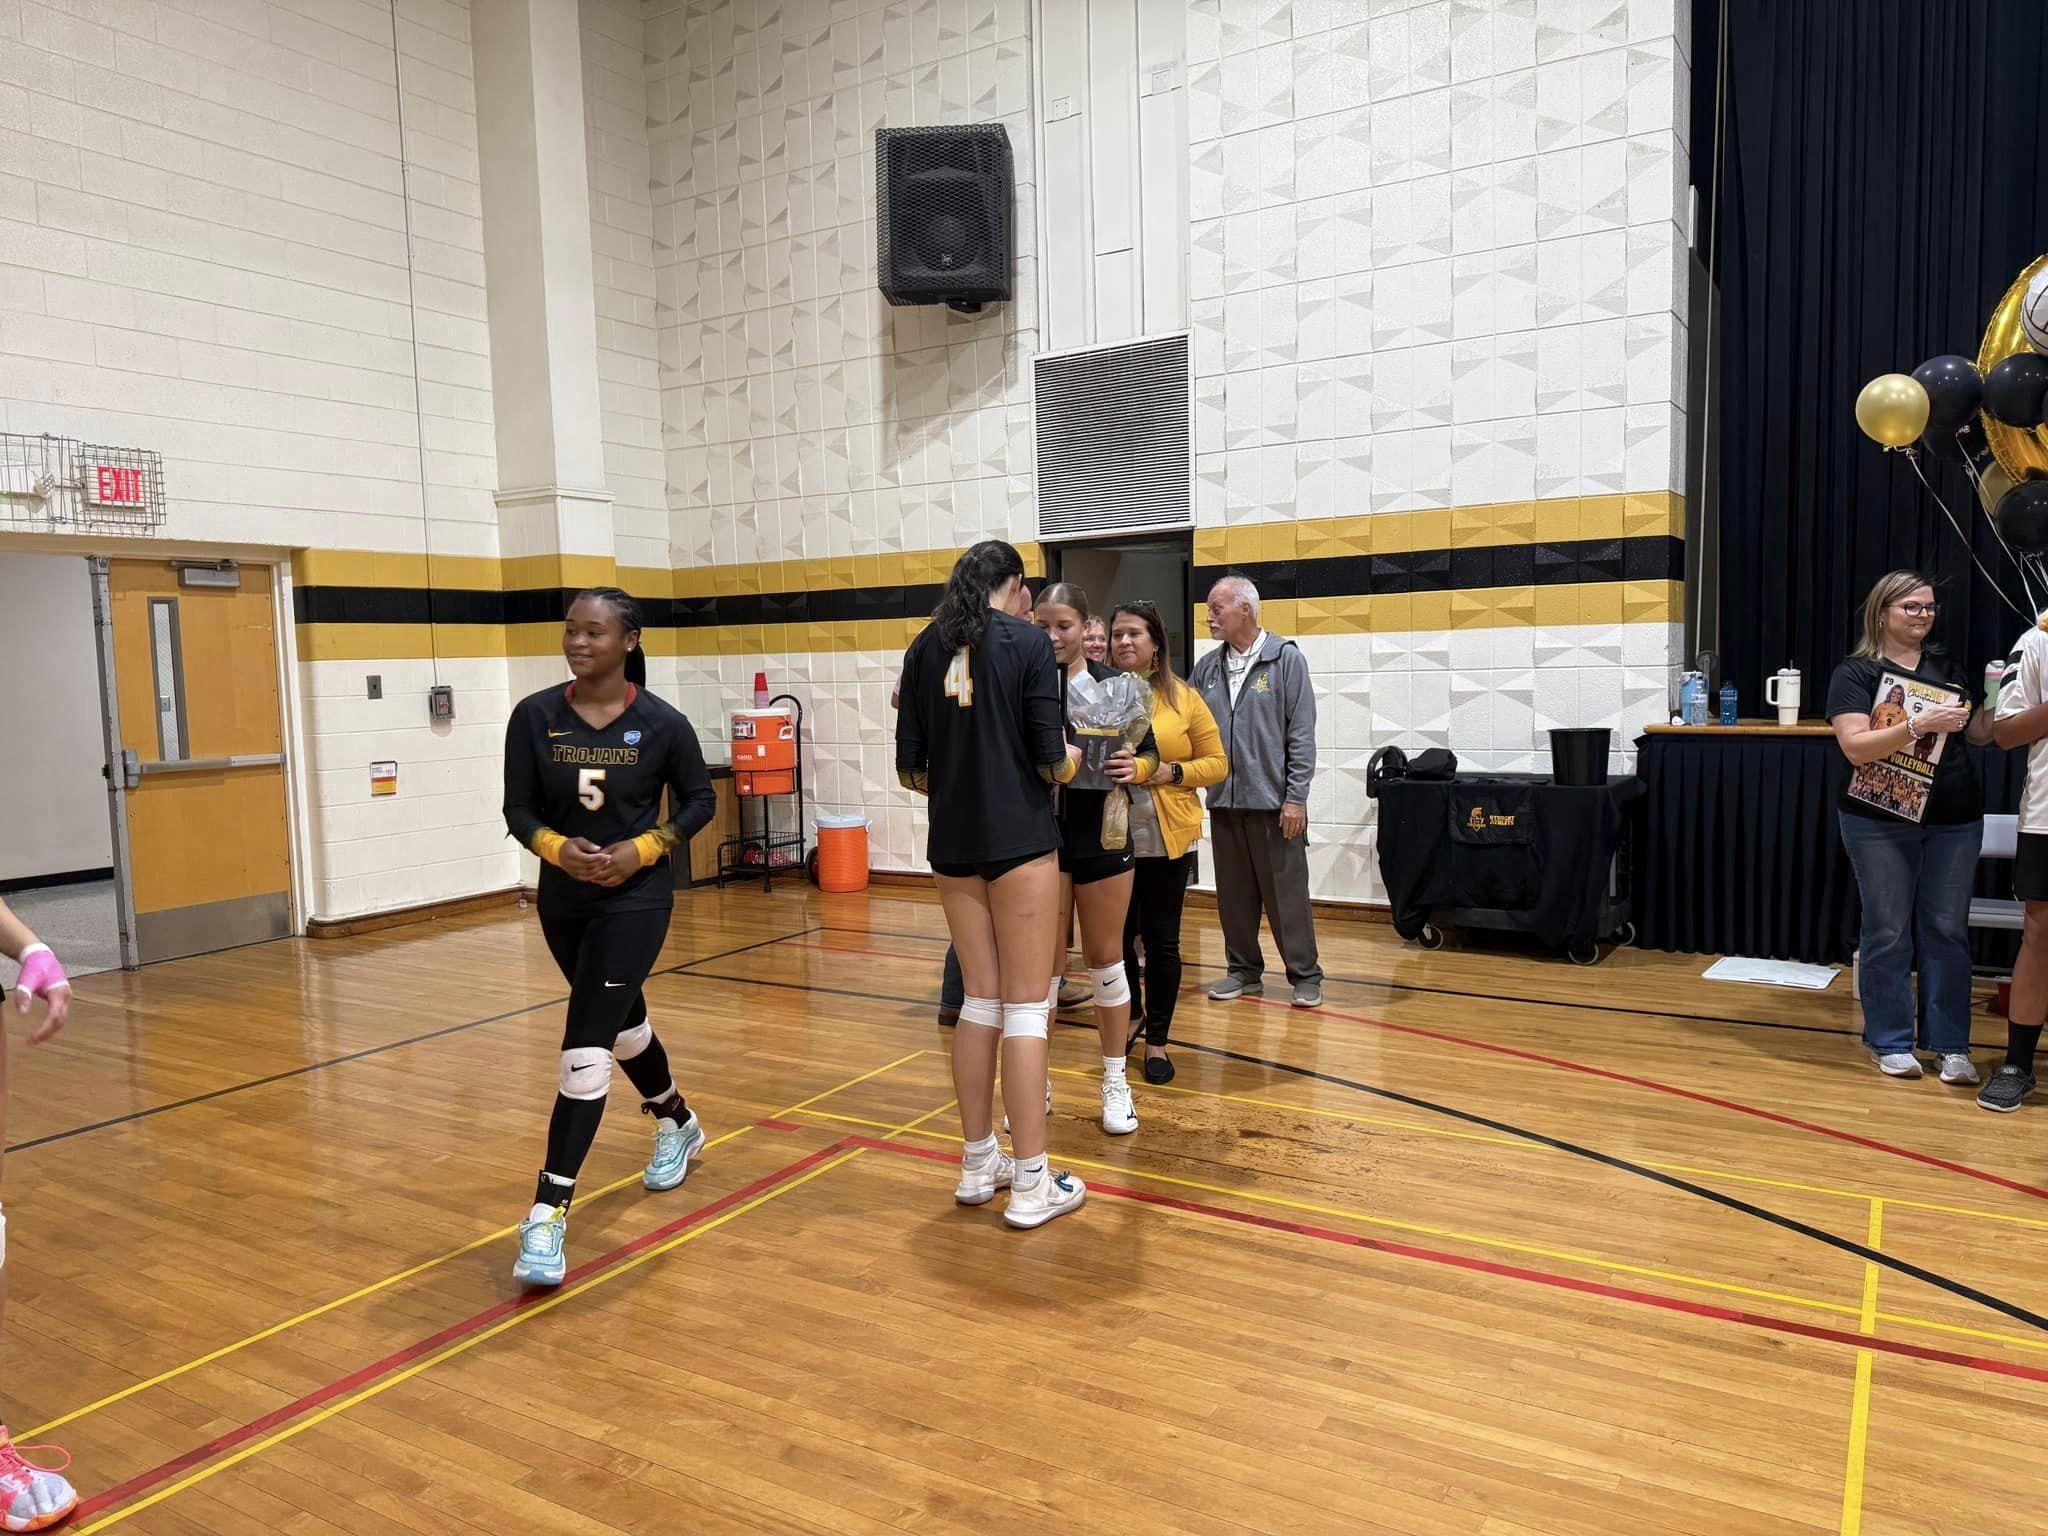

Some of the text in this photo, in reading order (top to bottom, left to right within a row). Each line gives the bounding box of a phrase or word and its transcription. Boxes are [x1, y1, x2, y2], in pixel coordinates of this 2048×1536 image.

[97, 466, 144, 503] EXIT
[943, 644, 974, 707] 4
[553, 744, 639, 765] TROJANS
[1891, 752, 1936, 777] VOLLEYBALL
[578, 768, 607, 812] 5
